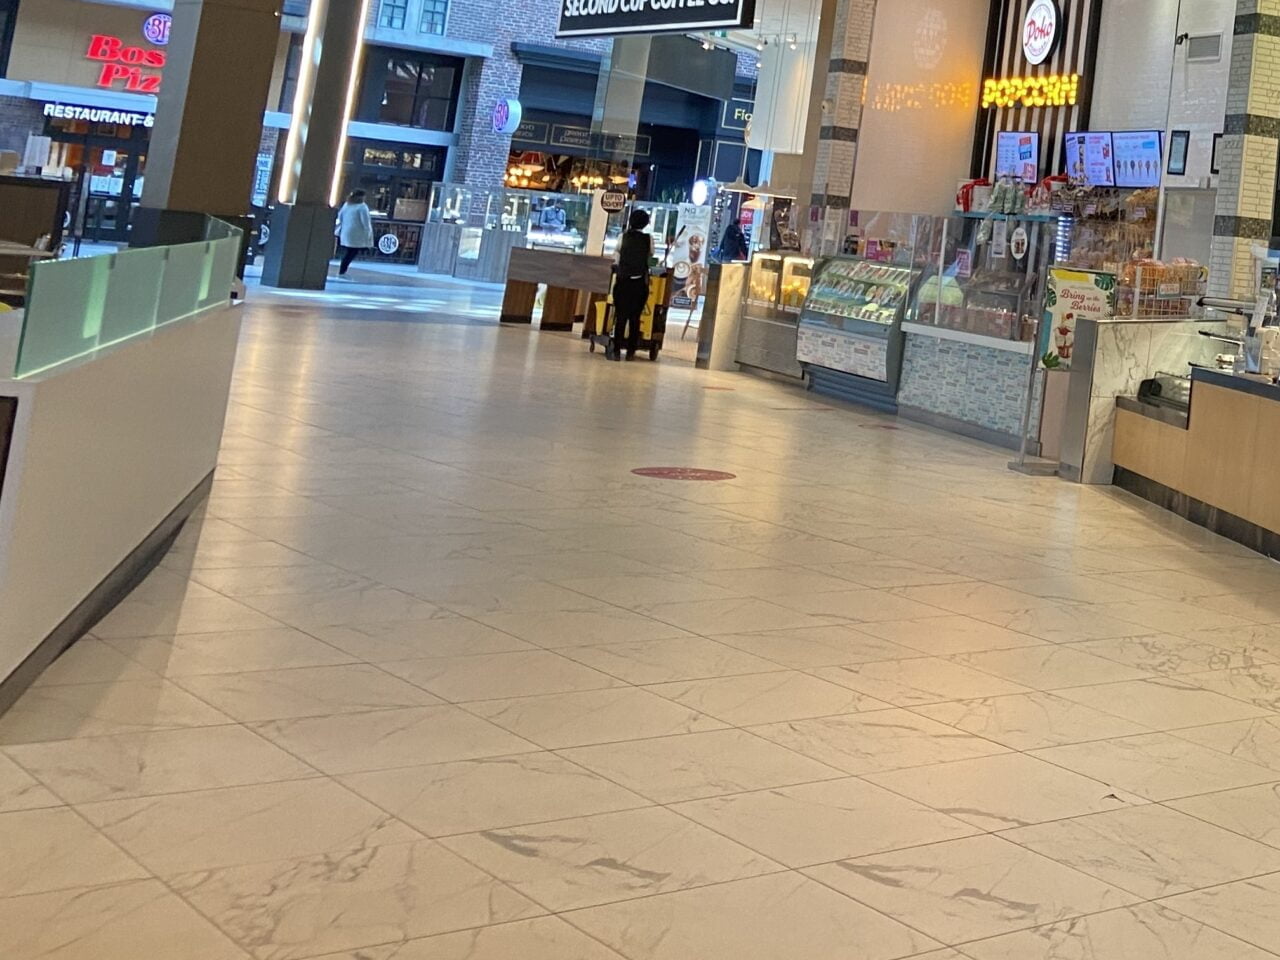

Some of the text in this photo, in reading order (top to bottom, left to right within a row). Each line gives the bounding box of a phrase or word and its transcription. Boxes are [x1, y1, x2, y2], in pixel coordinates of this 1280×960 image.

[97, 63, 162, 93] Piz
[982, 73, 1079, 109] POPCORN
[43, 103, 140, 126] RESTAURANT
[1060, 288, 1085, 304] Bring
